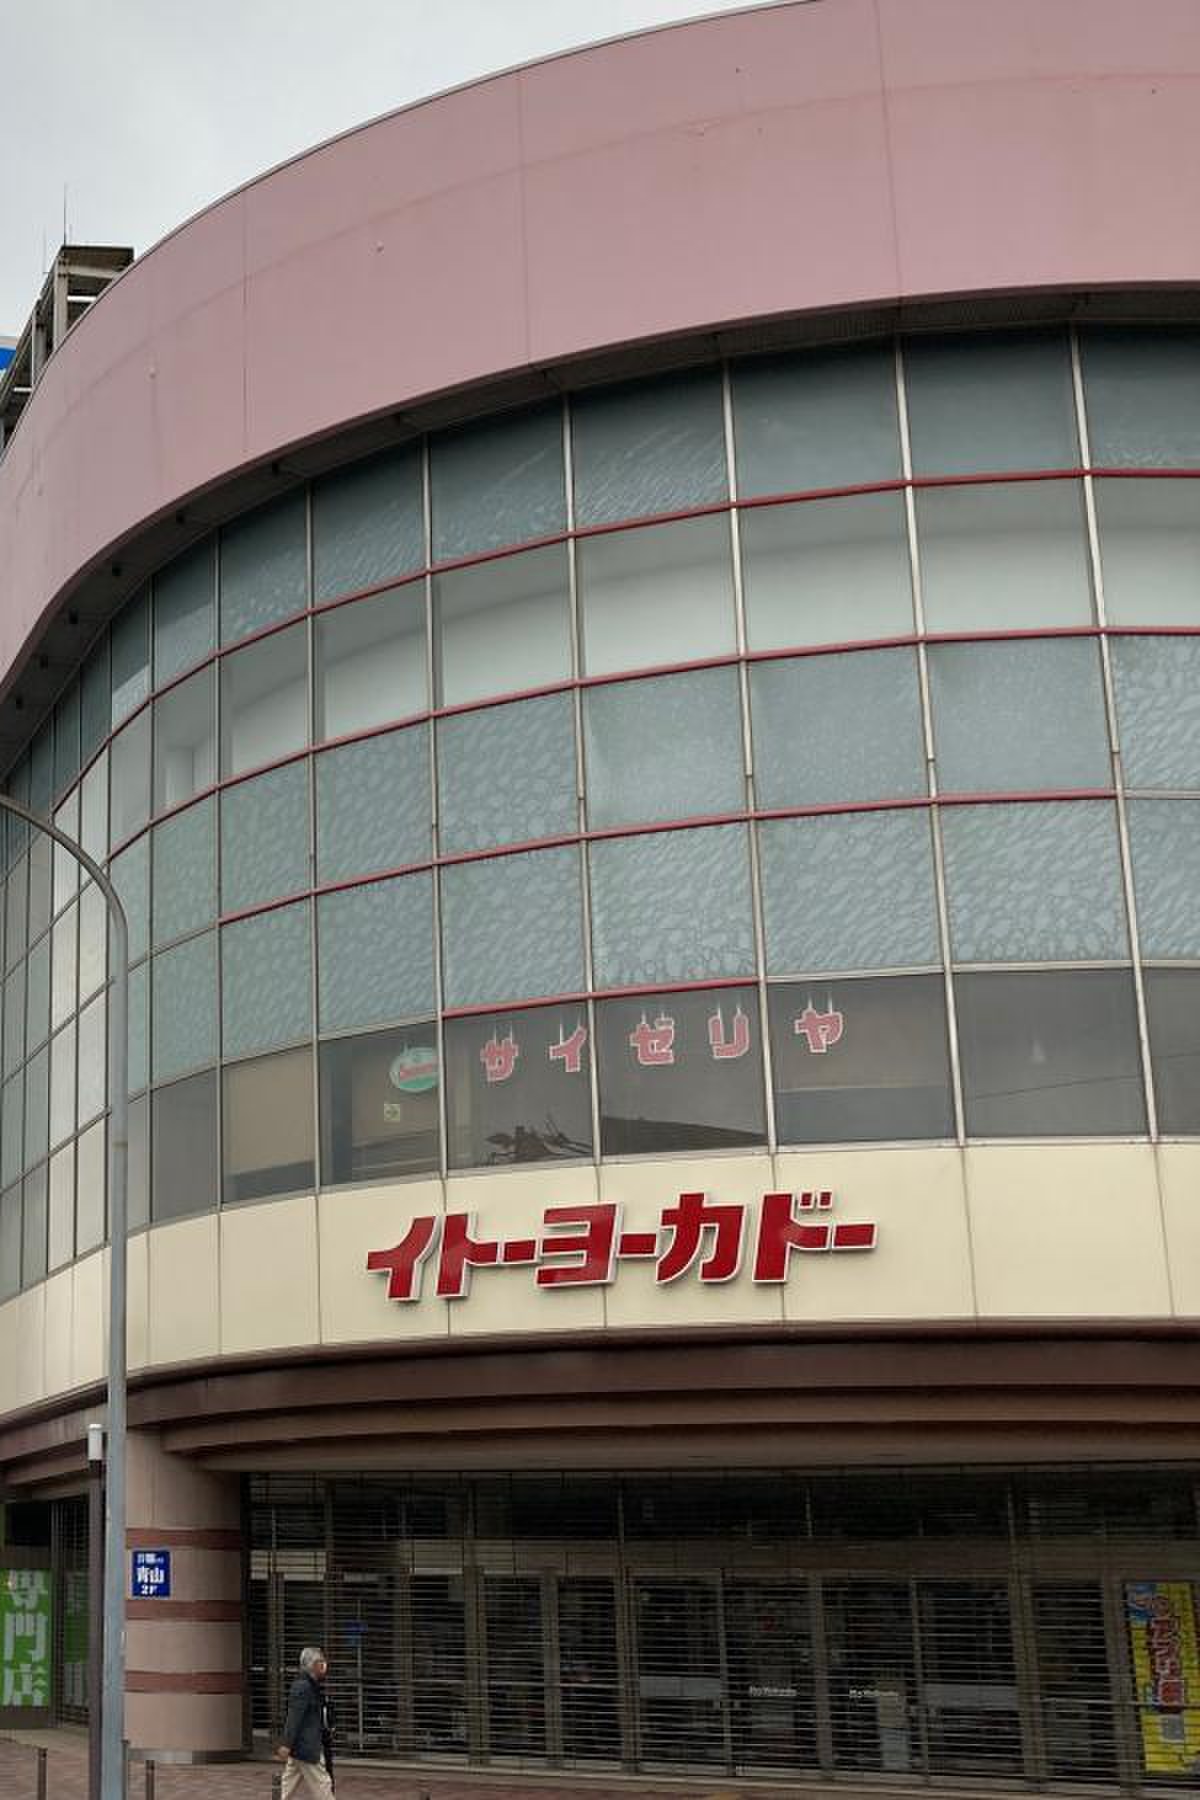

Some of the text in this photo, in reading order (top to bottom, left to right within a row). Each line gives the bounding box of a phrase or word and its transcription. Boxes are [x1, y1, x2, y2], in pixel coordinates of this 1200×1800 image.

[479, 1007, 844, 1083] サイゼリヤ
[366, 1189, 878, 1301] イトーヨーカドー
